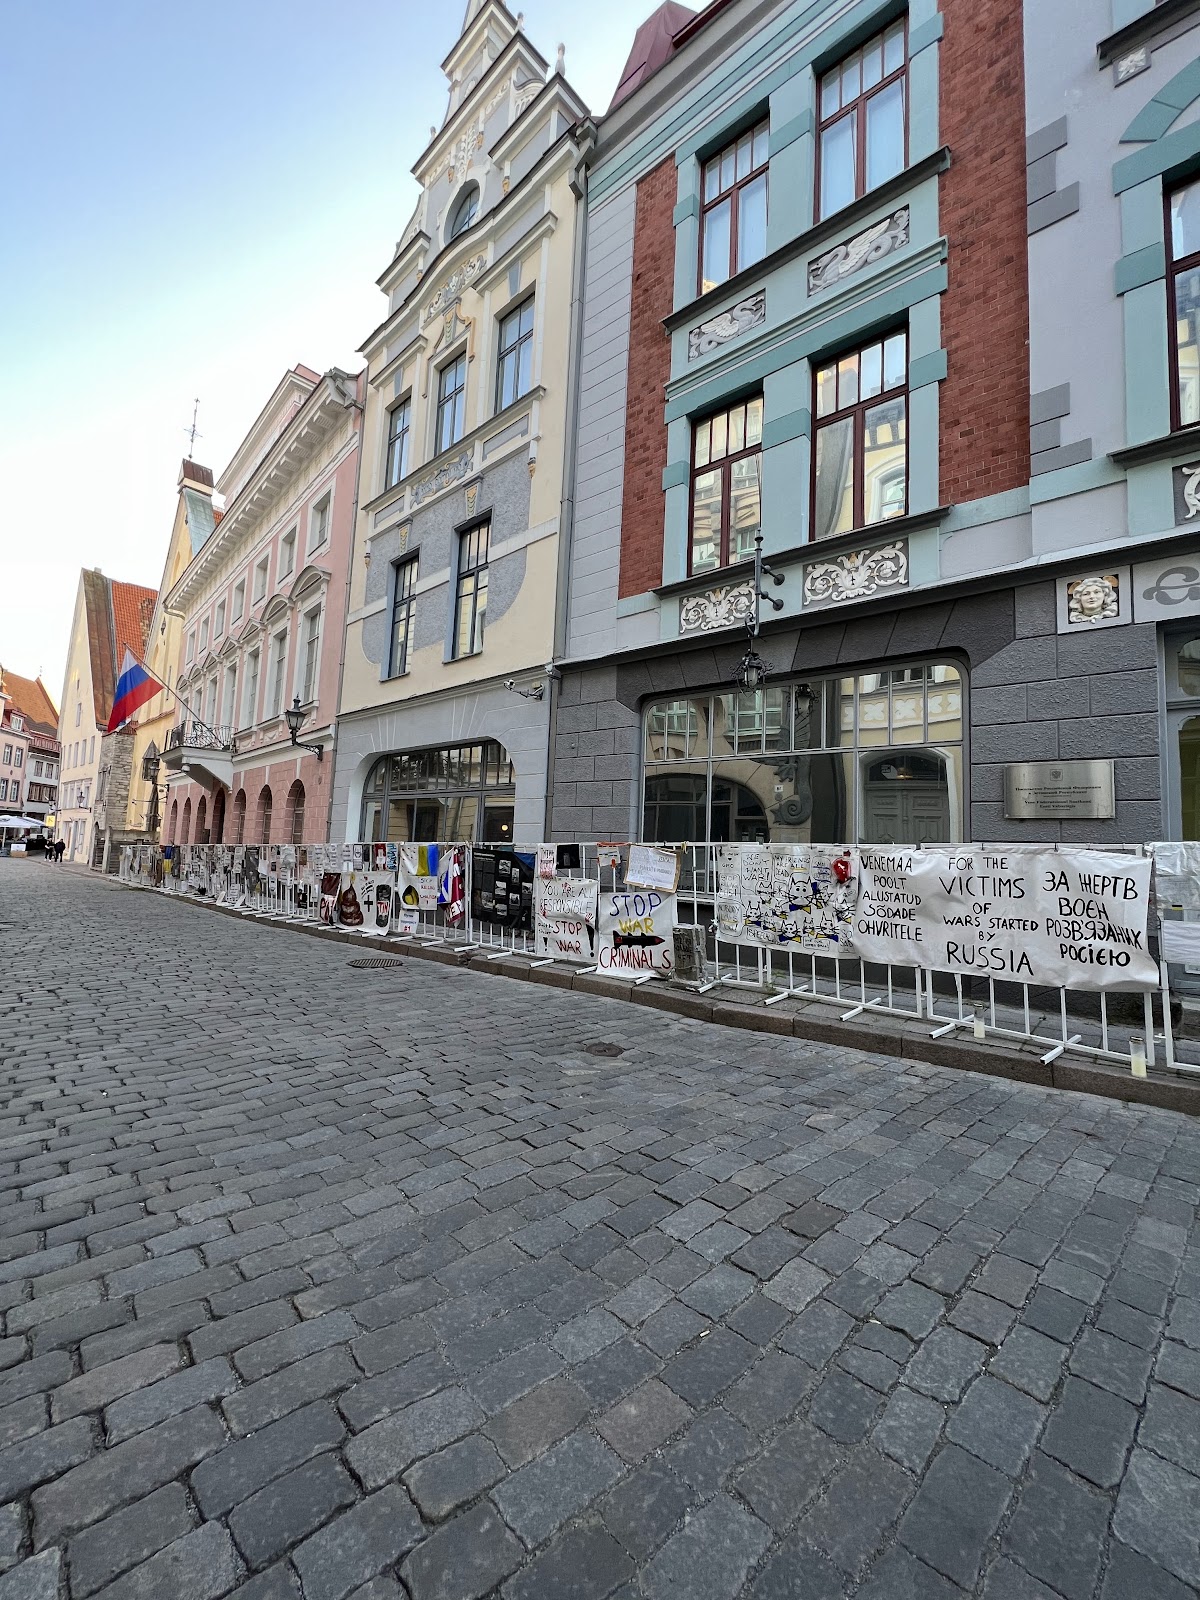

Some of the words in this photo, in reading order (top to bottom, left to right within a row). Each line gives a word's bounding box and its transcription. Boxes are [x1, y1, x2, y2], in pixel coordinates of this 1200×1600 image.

[860, 855, 912, 872] VENEMAA
[948, 857, 974, 870] FOR
[983, 857, 1009, 870] THE
[542, 880, 559, 897] YOU
[561, 885, 576, 898] ARE
[578, 887, 594, 899] ALL
[874, 875, 907, 890] POOLT
[938, 876, 1025, 899] VICTIMS
[1042, 870, 1070, 892] ЗА
[1079, 872, 1139, 900] ЖЕРТВ
[540, 898, 594, 914] RESPONSIBLE
[609, 892, 662, 917] STOP
[862, 890, 922, 906] ALUSTATUD
[863, 903, 916, 921] SÕDADE
[972, 902, 992, 914] OF
[1058, 897, 1110, 921] ВОЄН
[552, 920, 583, 936] STOP
[618, 917, 654, 934] WAR
[858, 919, 923, 942] OHVRITELE
[943, 915, 981, 927] WARS
[988, 917, 1039, 931] STARTED
[978, 930, 996, 942] BY
[555, 939, 582, 954] WAR
[599, 946, 672, 970] CRIMINALS
[946, 941, 1034, 976] RUSSIA
